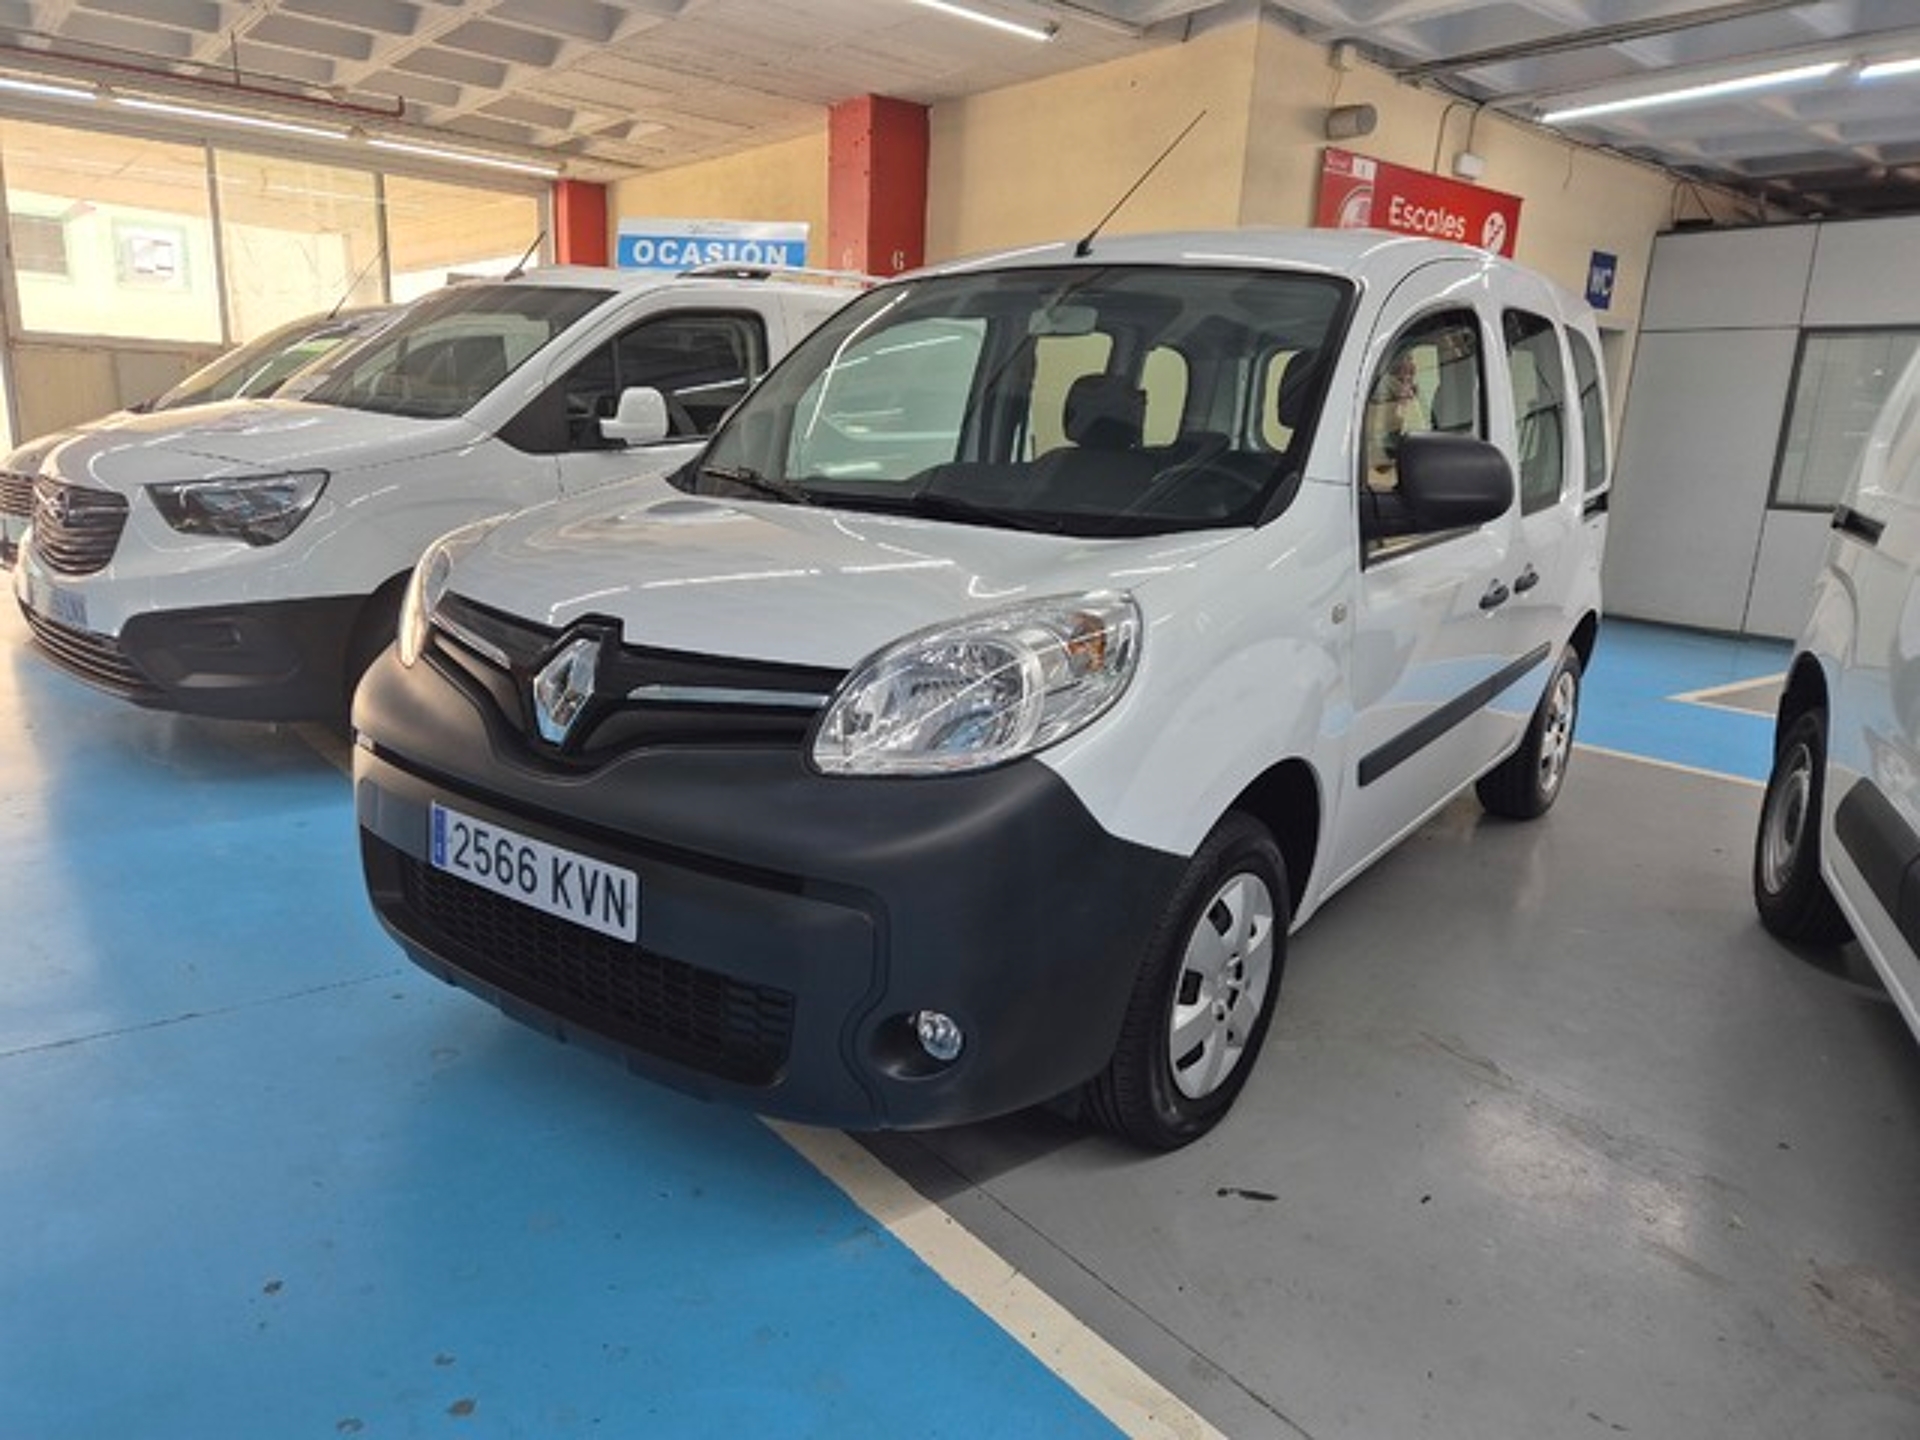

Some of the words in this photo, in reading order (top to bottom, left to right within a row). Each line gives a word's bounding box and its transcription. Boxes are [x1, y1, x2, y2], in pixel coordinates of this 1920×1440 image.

[1389, 195, 1466, 239] Escales
[453, 822, 537, 895] 2566
[552, 857, 627, 928] KVN
